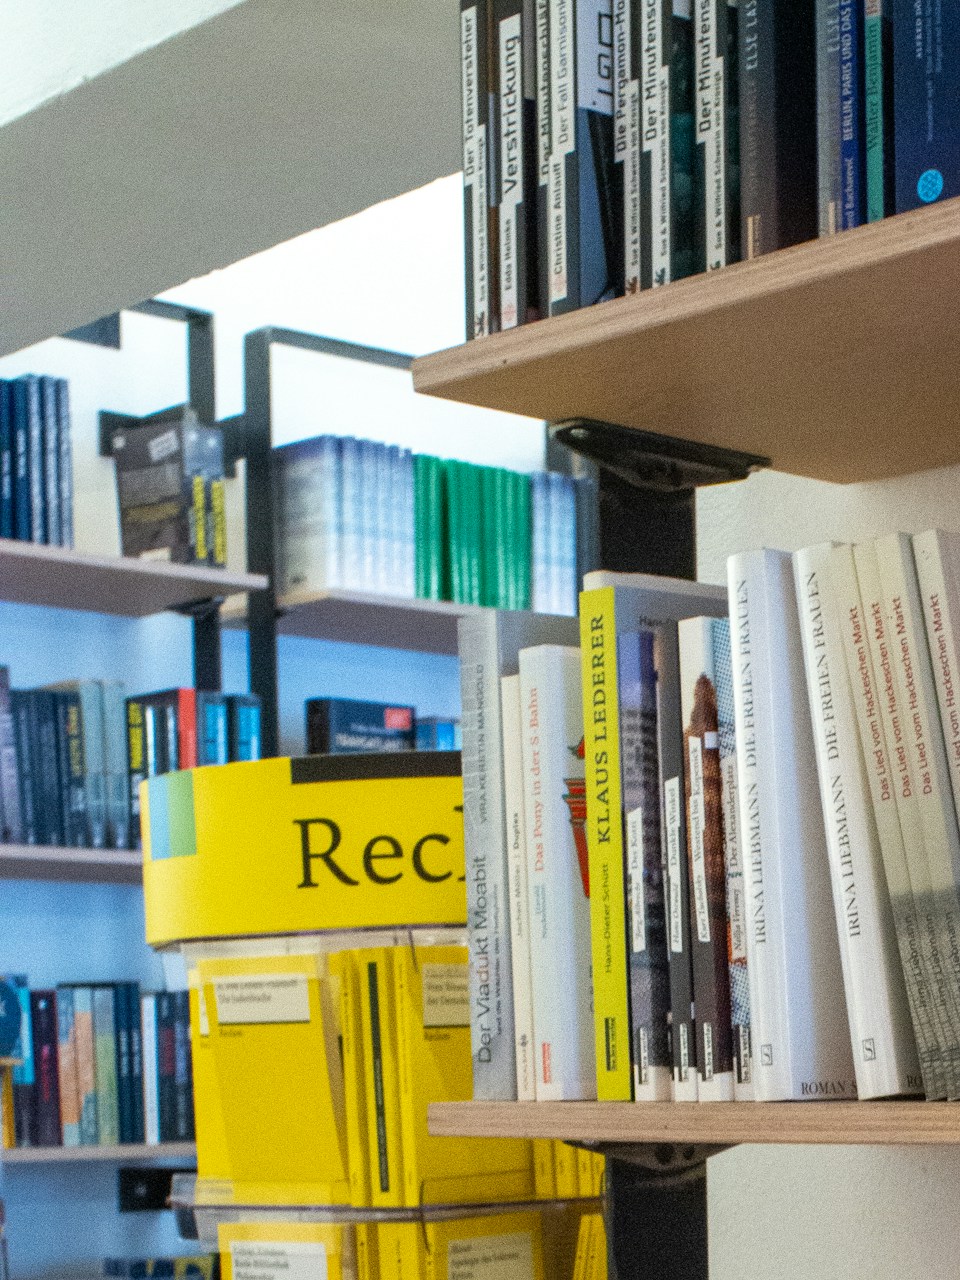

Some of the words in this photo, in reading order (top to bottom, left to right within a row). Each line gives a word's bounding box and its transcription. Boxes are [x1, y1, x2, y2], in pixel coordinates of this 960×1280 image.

[840, 7, 852, 32] DAS
[746, 33, 759, 70] ELSE
[841, 35, 853, 60] UND
[866, 23, 880, 96] Benjamin
[557, 83, 568, 111] Fall
[841, 62, 854, 95] PARIS
[502, 36, 520, 194] Verstrickung
[557, 117, 569, 144] Der
[644, 107, 657, 141] Der
[699, 98, 712, 132] Der
[842, 97, 854, 141] BERLIN,
[866, 100, 879, 152] Walter
[615, 132, 627, 153] Die
[463, 149, 475, 176] Der
[552, 163, 562, 210] Anlauff
[553, 215, 563, 275] Christine
[736, 578, 751, 656] FRAUEN
[806, 571, 826, 649] FRAUEN
[848, 605, 866, 644] Markt
[870, 601, 885, 640] Markt
[891, 596, 907, 635] Markt
[929, 593, 944, 632] Markt
[590, 613, 608, 741] LEDERER
[815, 654, 836, 722] FREIEN
[857, 646, 877, 717] Hackeschen
[878, 641, 898, 714] Hackeschen
[898, 637, 919, 710] Hackeschen
[936, 634, 956, 707] Hackeschen
[739, 661, 755, 728] FREIEN
[822, 725, 840, 761] DIE
[869, 720, 881, 747] vom
[890, 715, 901, 744] vom
[911, 712, 923, 740] vom
[948, 709, 960, 738] vom
[529, 750, 541, 776] der
[743, 732, 757, 768] DIE
[873, 749, 887, 775] Lied
[894, 745, 908, 773] Lied
[915, 742, 928, 769] Lied
[531, 781, 541, 796] in
[594, 750, 611, 845] KLAUS
[880, 777, 892, 801] Das
[901, 774, 913, 798] Das
[921, 771, 933, 795] Das
[531, 800, 545, 838] Pony
[726, 764, 738, 844] Alexanderplatz
[512, 812, 521, 850] Duplex
[746, 781, 764, 884] LIEBMANN
[831, 774, 855, 878] LIEBMANN
[293, 803, 464, 890] Rec
[533, 843, 544, 872] Das
[728, 850, 738, 868] Der
[471, 856, 489, 931] Moabit
[599, 863, 610, 902] Schütt
[753, 890, 768, 945] IRINA
[843, 881, 861, 939] IRINA
[601, 903, 613, 974] Hans-Dieter
[475, 936, 491, 1018] Viadukt
[477, 1024, 493, 1064] Der
[801, 1078, 848, 1096] ROMAN
